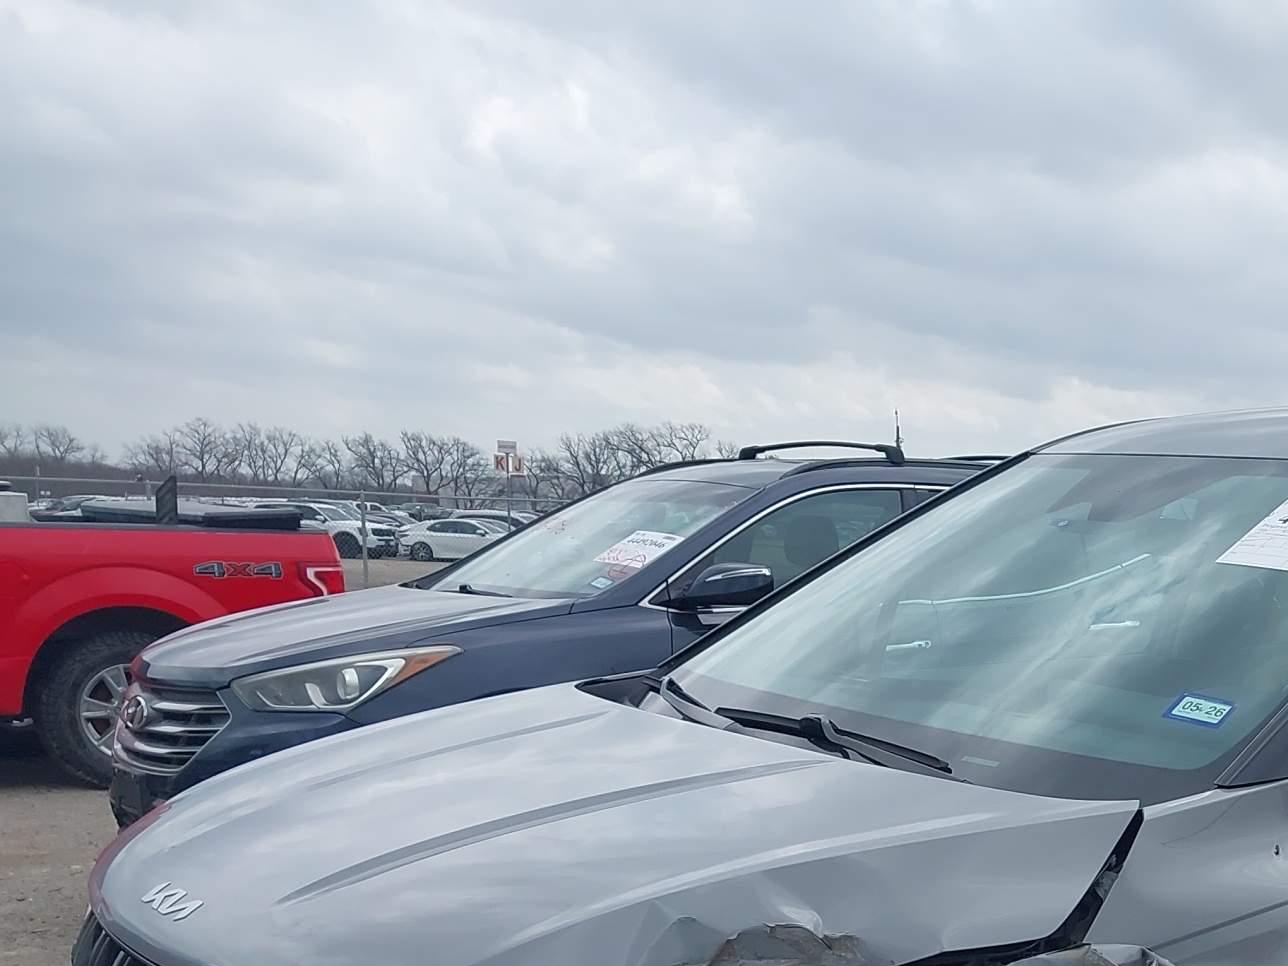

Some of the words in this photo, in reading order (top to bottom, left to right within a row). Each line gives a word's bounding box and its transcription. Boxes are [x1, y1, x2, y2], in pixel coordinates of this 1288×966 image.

[495, 456, 505, 471] K
[514, 457, 522, 472] J
[1182, 700, 1202, 712] 05
[1204, 706, 1226, 717] 26
